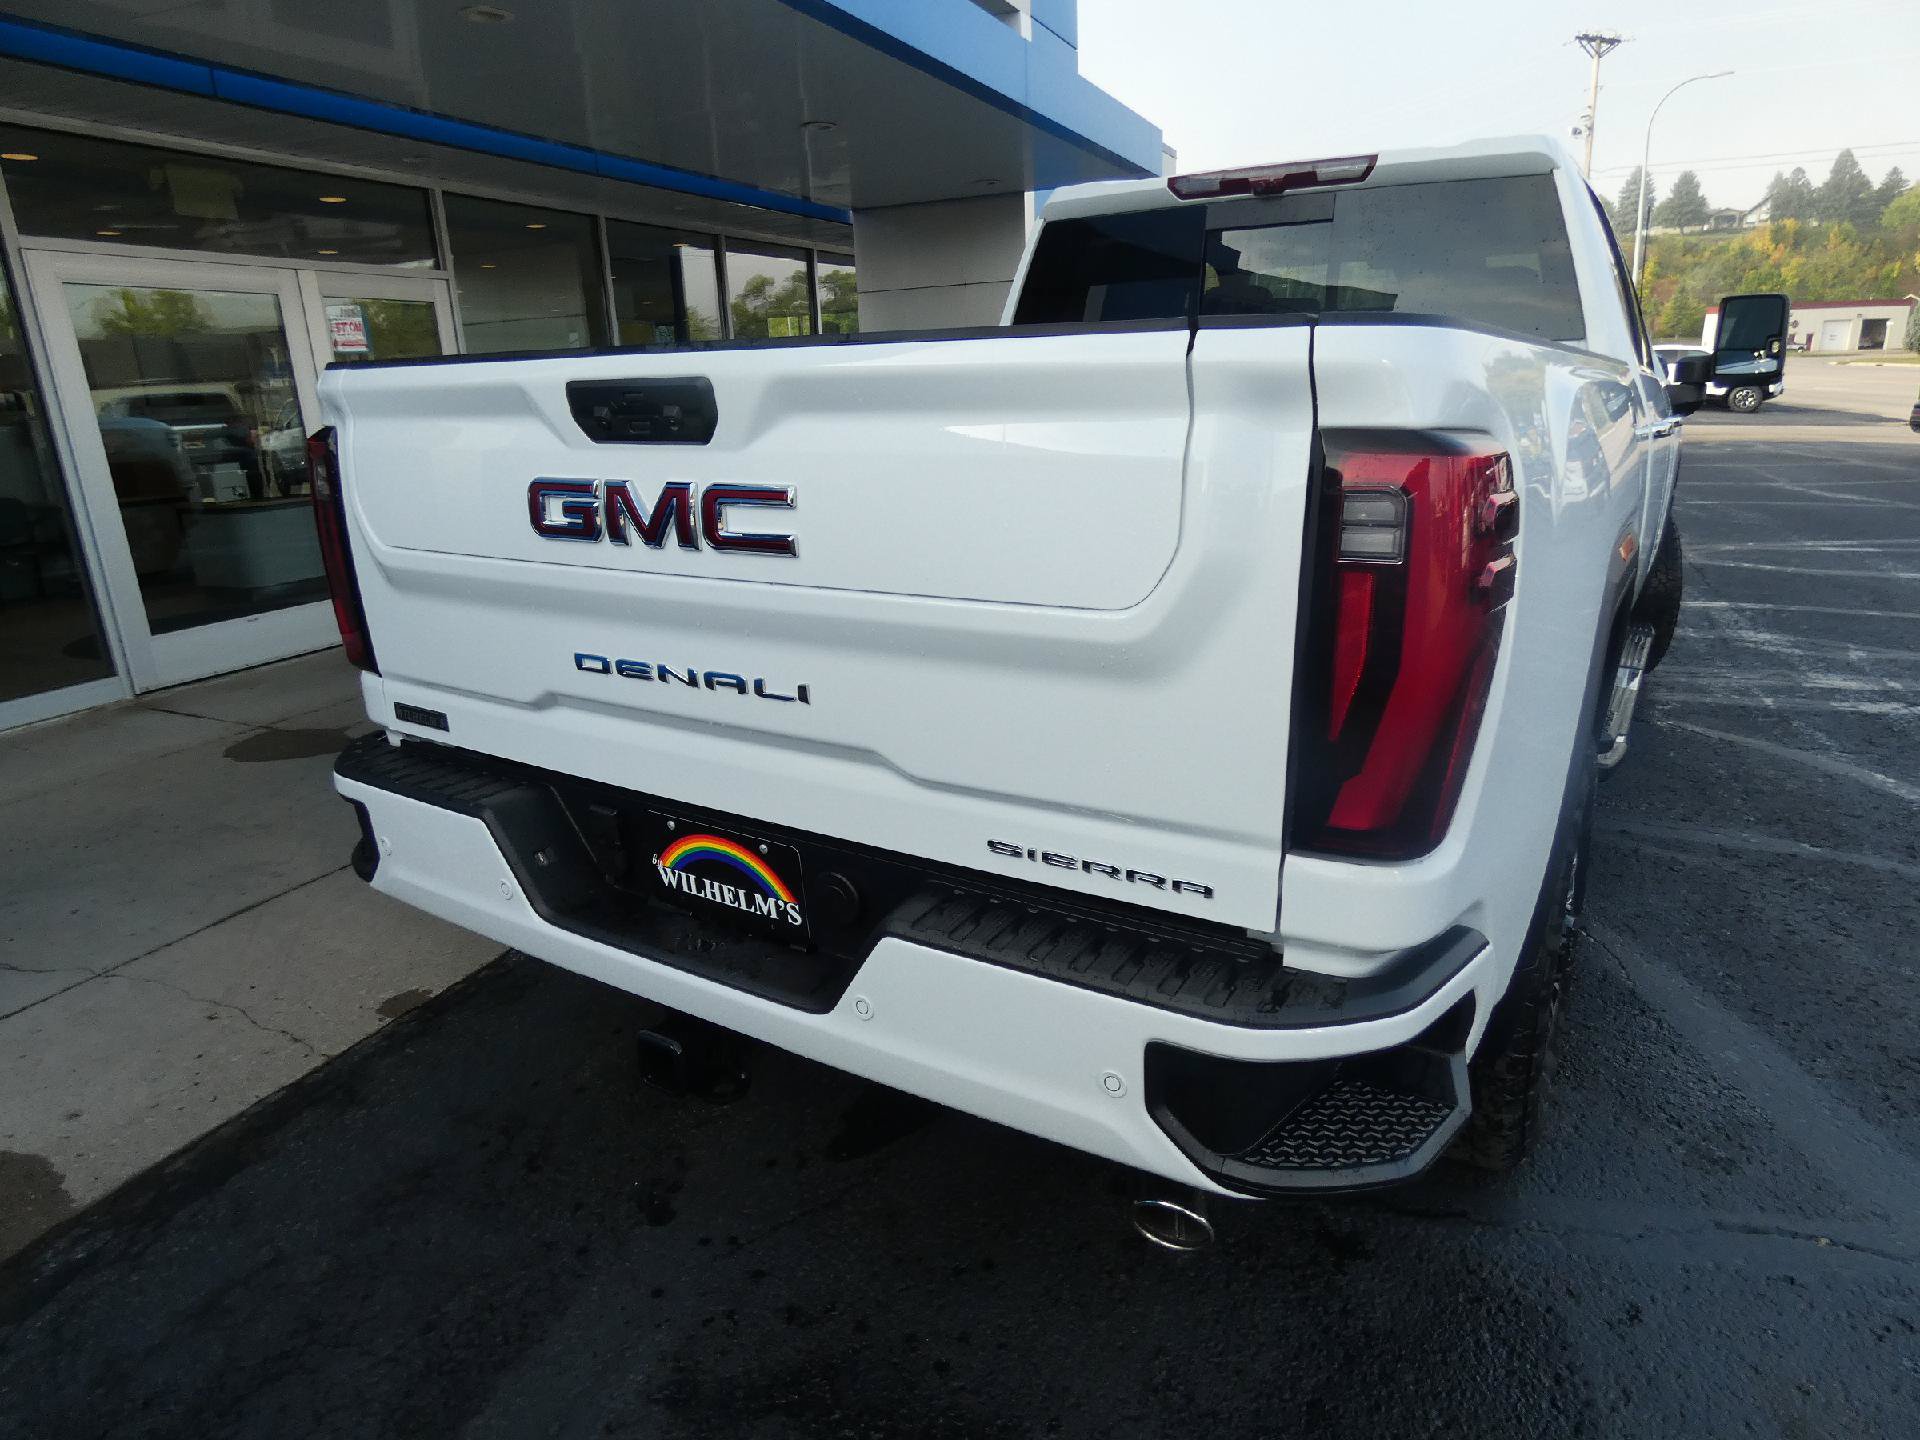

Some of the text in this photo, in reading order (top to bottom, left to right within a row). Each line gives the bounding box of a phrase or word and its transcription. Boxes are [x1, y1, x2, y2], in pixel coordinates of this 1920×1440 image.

[527, 476, 798, 558] GMC
[574, 652, 811, 705] DENALI
[657, 865, 803, 926] WILHELM'S
[987, 839, 1214, 899] SIERRA
